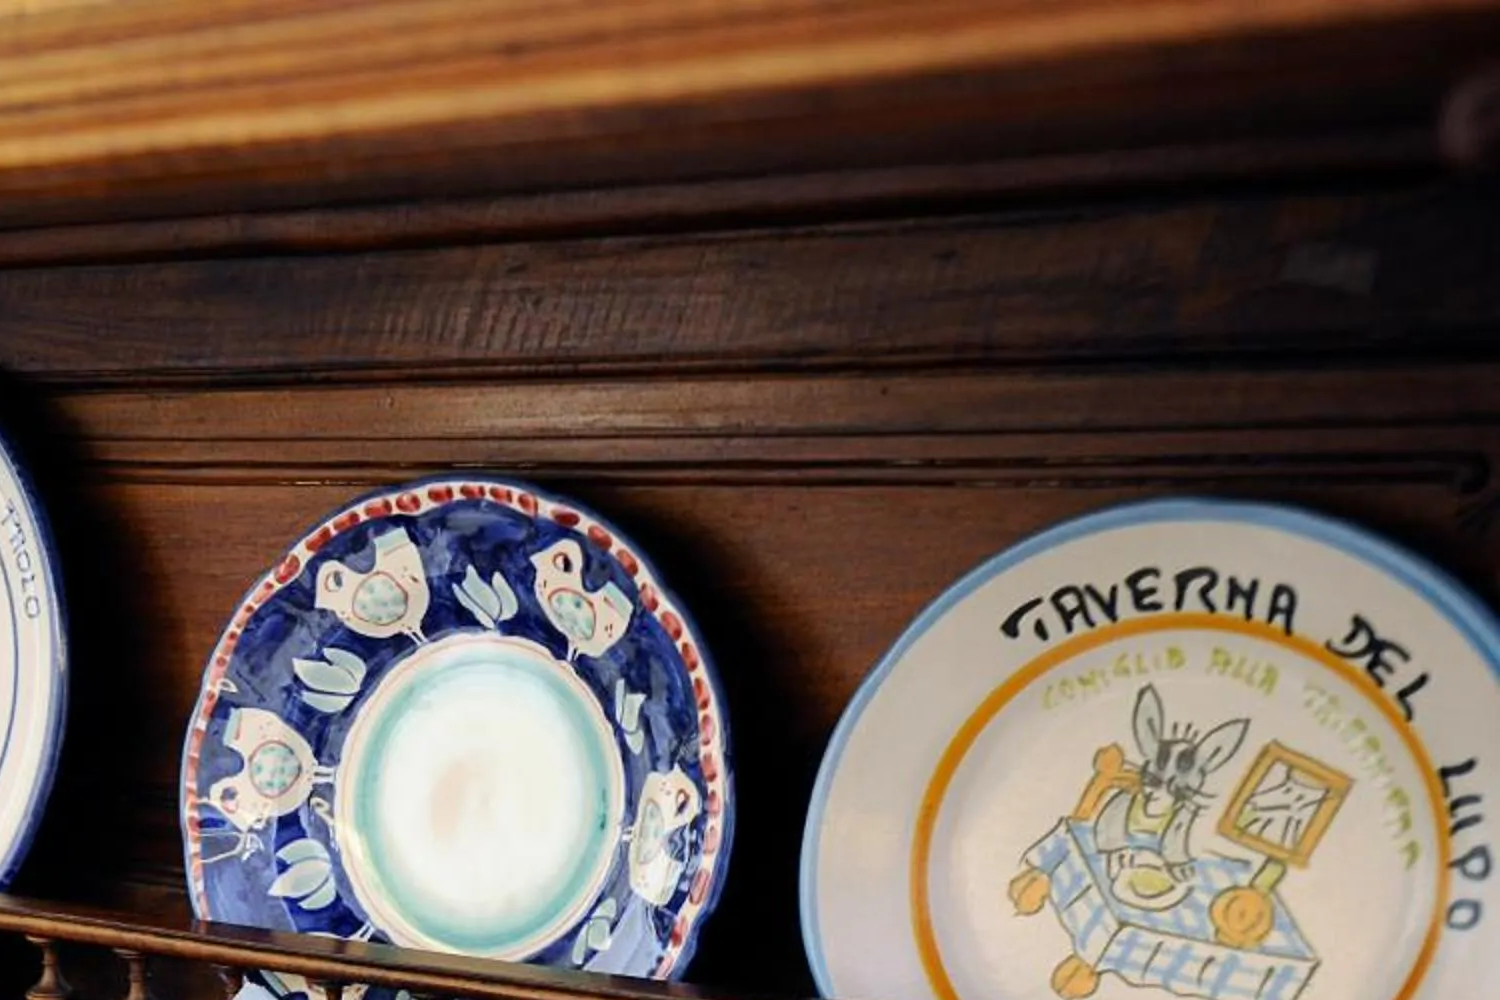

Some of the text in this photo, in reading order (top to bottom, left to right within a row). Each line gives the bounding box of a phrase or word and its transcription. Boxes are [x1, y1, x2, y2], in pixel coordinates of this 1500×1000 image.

[1001, 566, 1297, 641] TAVERNA
[1325, 614, 1430, 723] DEL
[1438, 756, 1491, 930] LUPO
